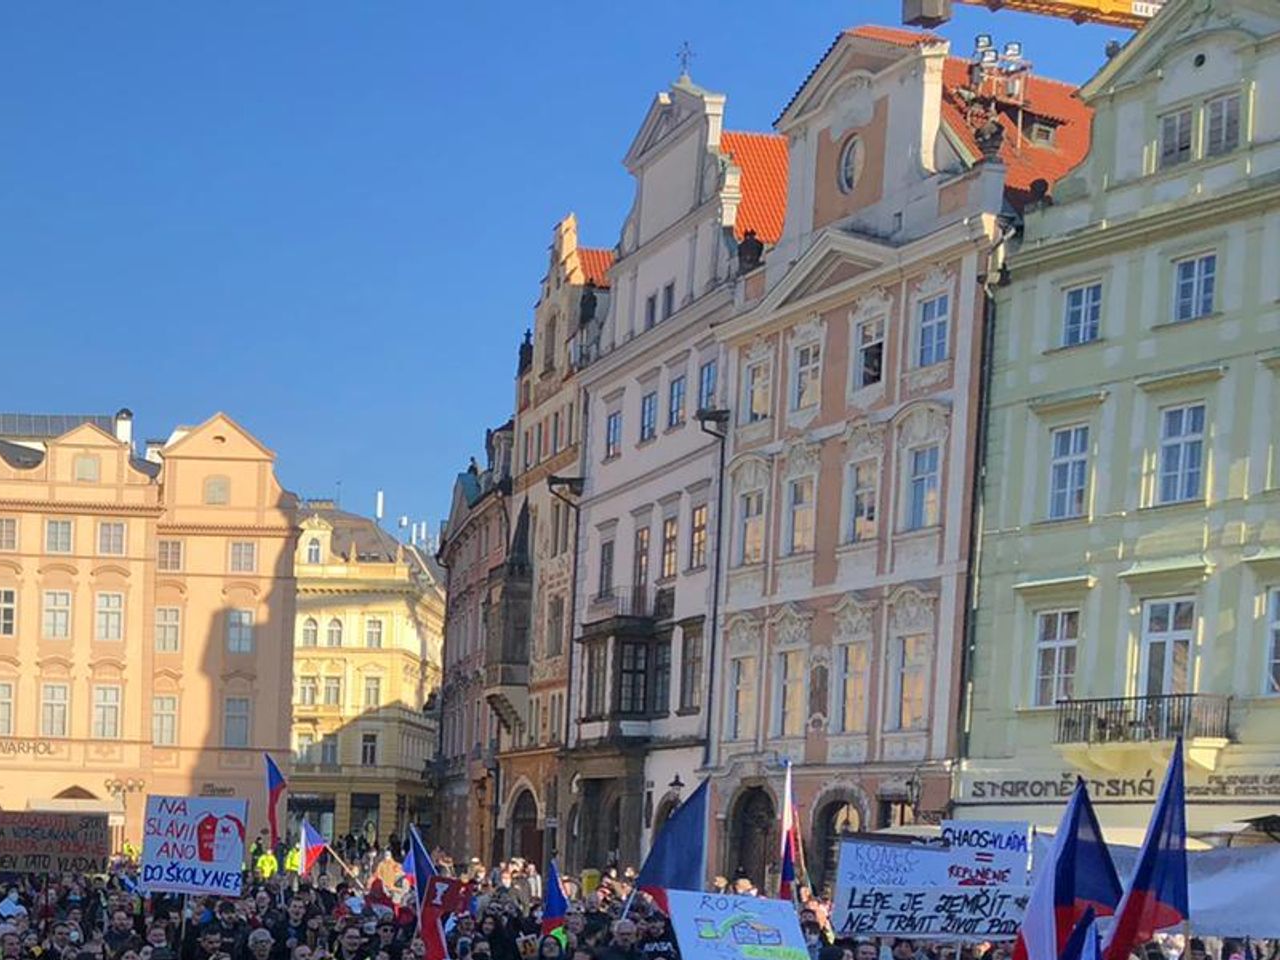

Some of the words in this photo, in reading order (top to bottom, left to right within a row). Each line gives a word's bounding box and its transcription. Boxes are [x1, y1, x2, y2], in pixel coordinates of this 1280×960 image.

[971, 768, 1155, 798] STAROMĚTSKÁ
[158, 798, 187, 817] NA
[156, 841, 197, 861] ANO
[143, 864, 164, 883] DO
[698, 894, 753, 913] ROK
[900, 892, 926, 912] JE
